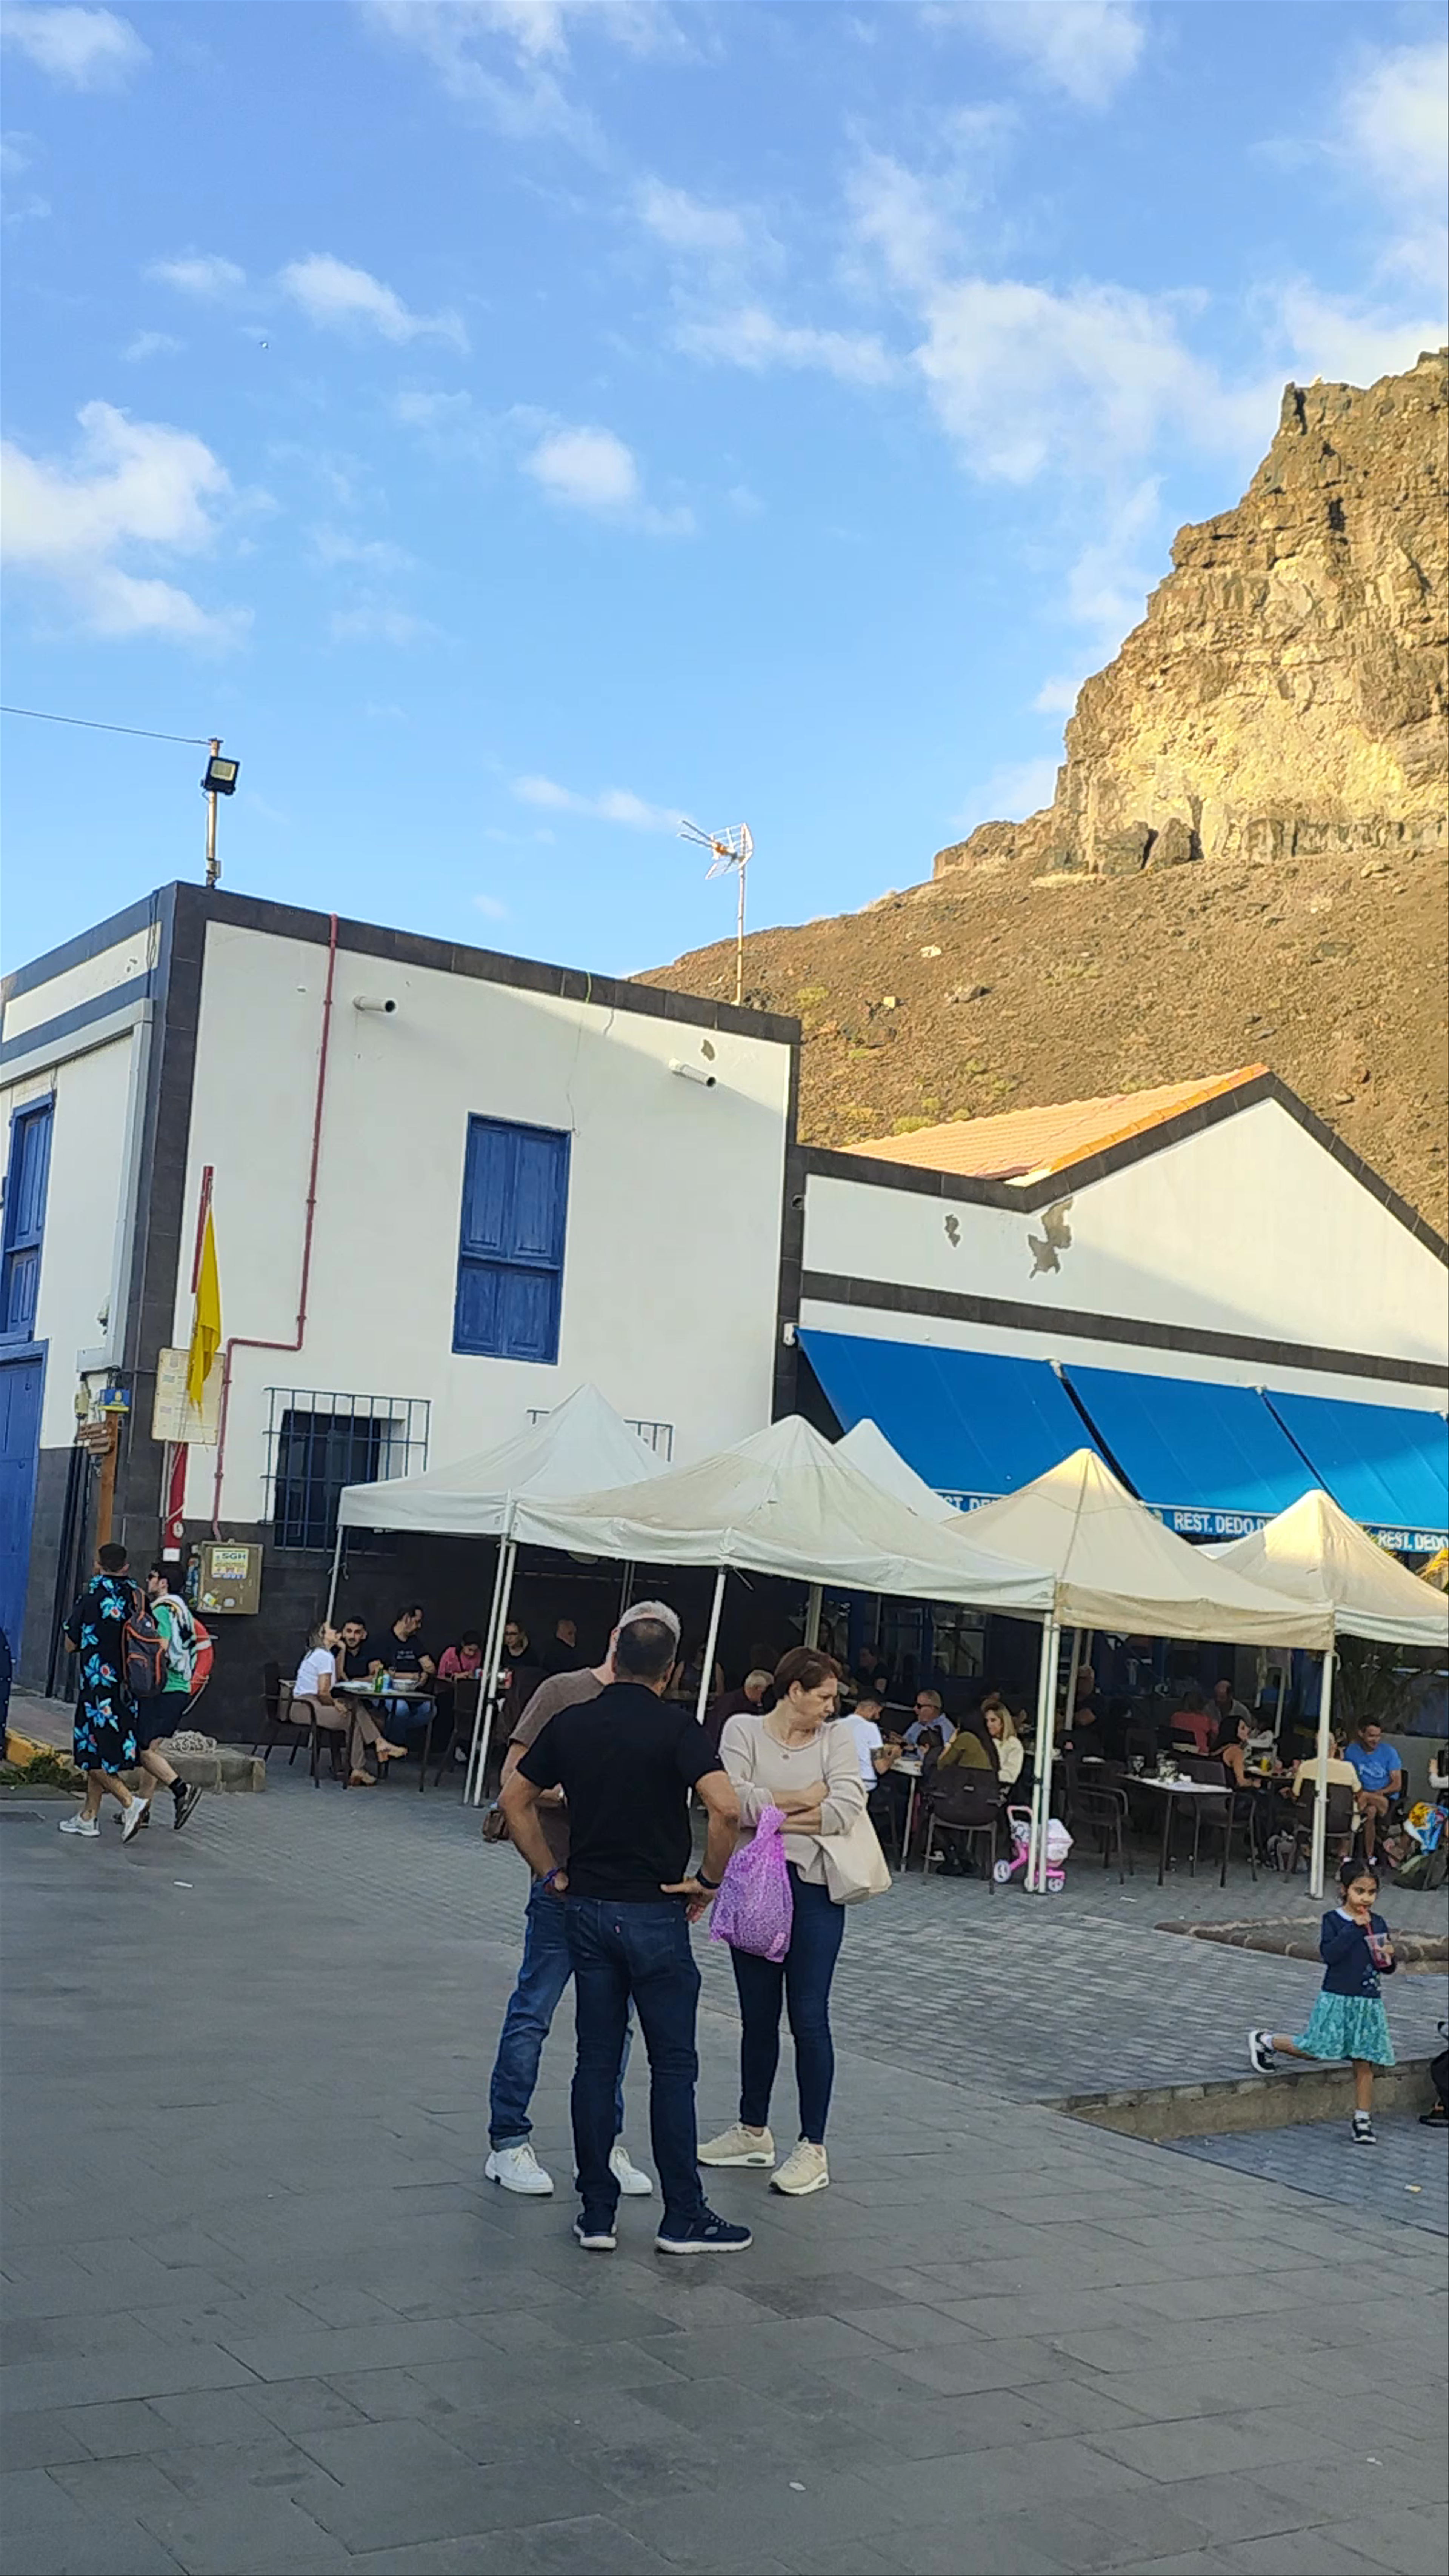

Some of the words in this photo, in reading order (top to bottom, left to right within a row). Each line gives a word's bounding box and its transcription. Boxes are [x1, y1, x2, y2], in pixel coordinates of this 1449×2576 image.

[1174, 1512, 1212, 1532] REST.
[1215, 1515, 1254, 1535] DEDO
[1378, 1530, 1412, 1550] REST.
